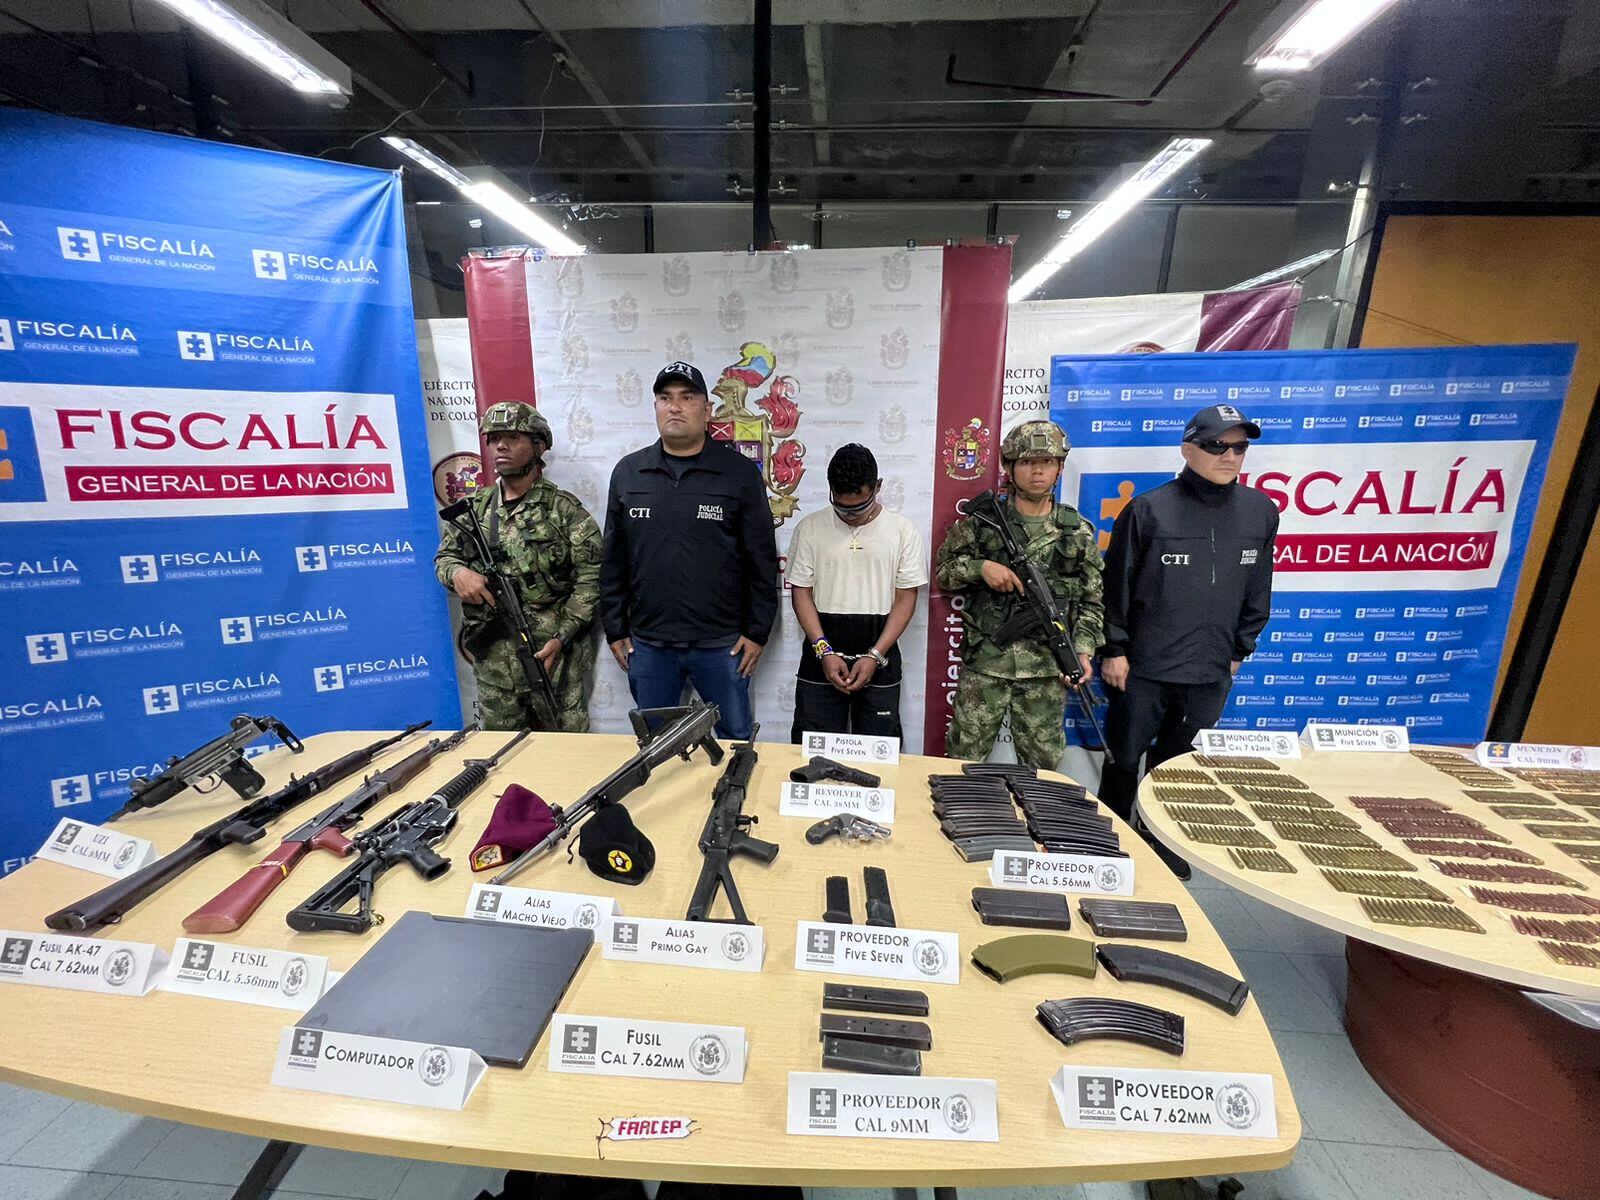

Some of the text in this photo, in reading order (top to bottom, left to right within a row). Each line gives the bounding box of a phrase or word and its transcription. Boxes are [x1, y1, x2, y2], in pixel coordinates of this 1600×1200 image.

[102, 233, 215, 258] FISCALÍA
[288, 253, 378, 272] FISCALÍA
[16, 321, 137, 341] FISCALÍA
[216, 334, 314, 351] FISCALÍA
[665, 363, 692, 374] CTI
[1006, 368, 1045, 379] RCITO
[1002, 385, 1049, 396] CIONAL
[1003, 400, 1049, 410] COLOM
[431, 411, 477, 420] DE COLO
[55, 404, 388, 450] FISCALÍA
[77, 467, 386, 494] GENERAL DE LA NACIÓN
[1239, 457, 1505, 516] SCALÍA
[629, 508, 651, 518] CTI
[697, 512, 723, 520] JUDICIAL
[160, 547, 261, 566] FISCALÍA
[329, 539, 413, 557] FISCALÍA
[1315, 544, 1351, 564] DE
[1358, 544, 1388, 563] LA
[1388, 537, 1488, 563] NACIÓN
[0, 557, 78, 575] CALÍA
[1161, 554, 1189, 564] CTI
[255, 606, 347, 627] FISCALÍA
[71, 621, 182, 644] FISCALÍA
[346, 654, 428, 675] FISCALÍA
[182, 672, 280, 696] FISCALÍA
[0, 694, 102, 720] ISCALÍA
[1334, 729, 1378, 737] MUNICIÓN
[95, 763, 170, 785] FISCA
[816, 788, 861, 798] REVOLVER
[814, 800, 832, 808] CAL
[93, 833, 109, 844] UZI
[72, 844, 88, 857] CAL
[1028, 859, 1094, 873] PROVEEDOR
[1030, 875, 1048, 885] CAL
[1053, 877, 1090, 888] 5.56MM
[524, 896, 551, 909] ALIAS
[502, 910, 538, 923] MACHO
[541, 914, 566, 926] VIEJO
[665, 927, 695, 938] ALIAS
[840, 931, 909, 947] PROVEEDOR
[40, 941, 102, 957] FUSIL AK-47
[651, 942, 708, 954] PRIMO GAY
[845, 948, 903, 964] FIVE SEVEN
[30, 958, 50, 972] CAL
[54, 960, 99, 976] 7.62MM
[232, 952, 268, 967] FUSIL
[206, 967, 231, 982] CAL
[234, 974, 279, 989] 5.56mm
[626, 1029, 661, 1046] FUSIL
[325, 1045, 414, 1070] COMPUTADOR
[601, 1050, 684, 1069] CAL 7.62MM
[1114, 1079, 1214, 1101] PROVEEDOR
[843, 1094, 941, 1110] PROVEEDOR
[1120, 1106, 1211, 1124] CAL 7.62MM
[855, 1116, 928, 1133] CAL 9MM
